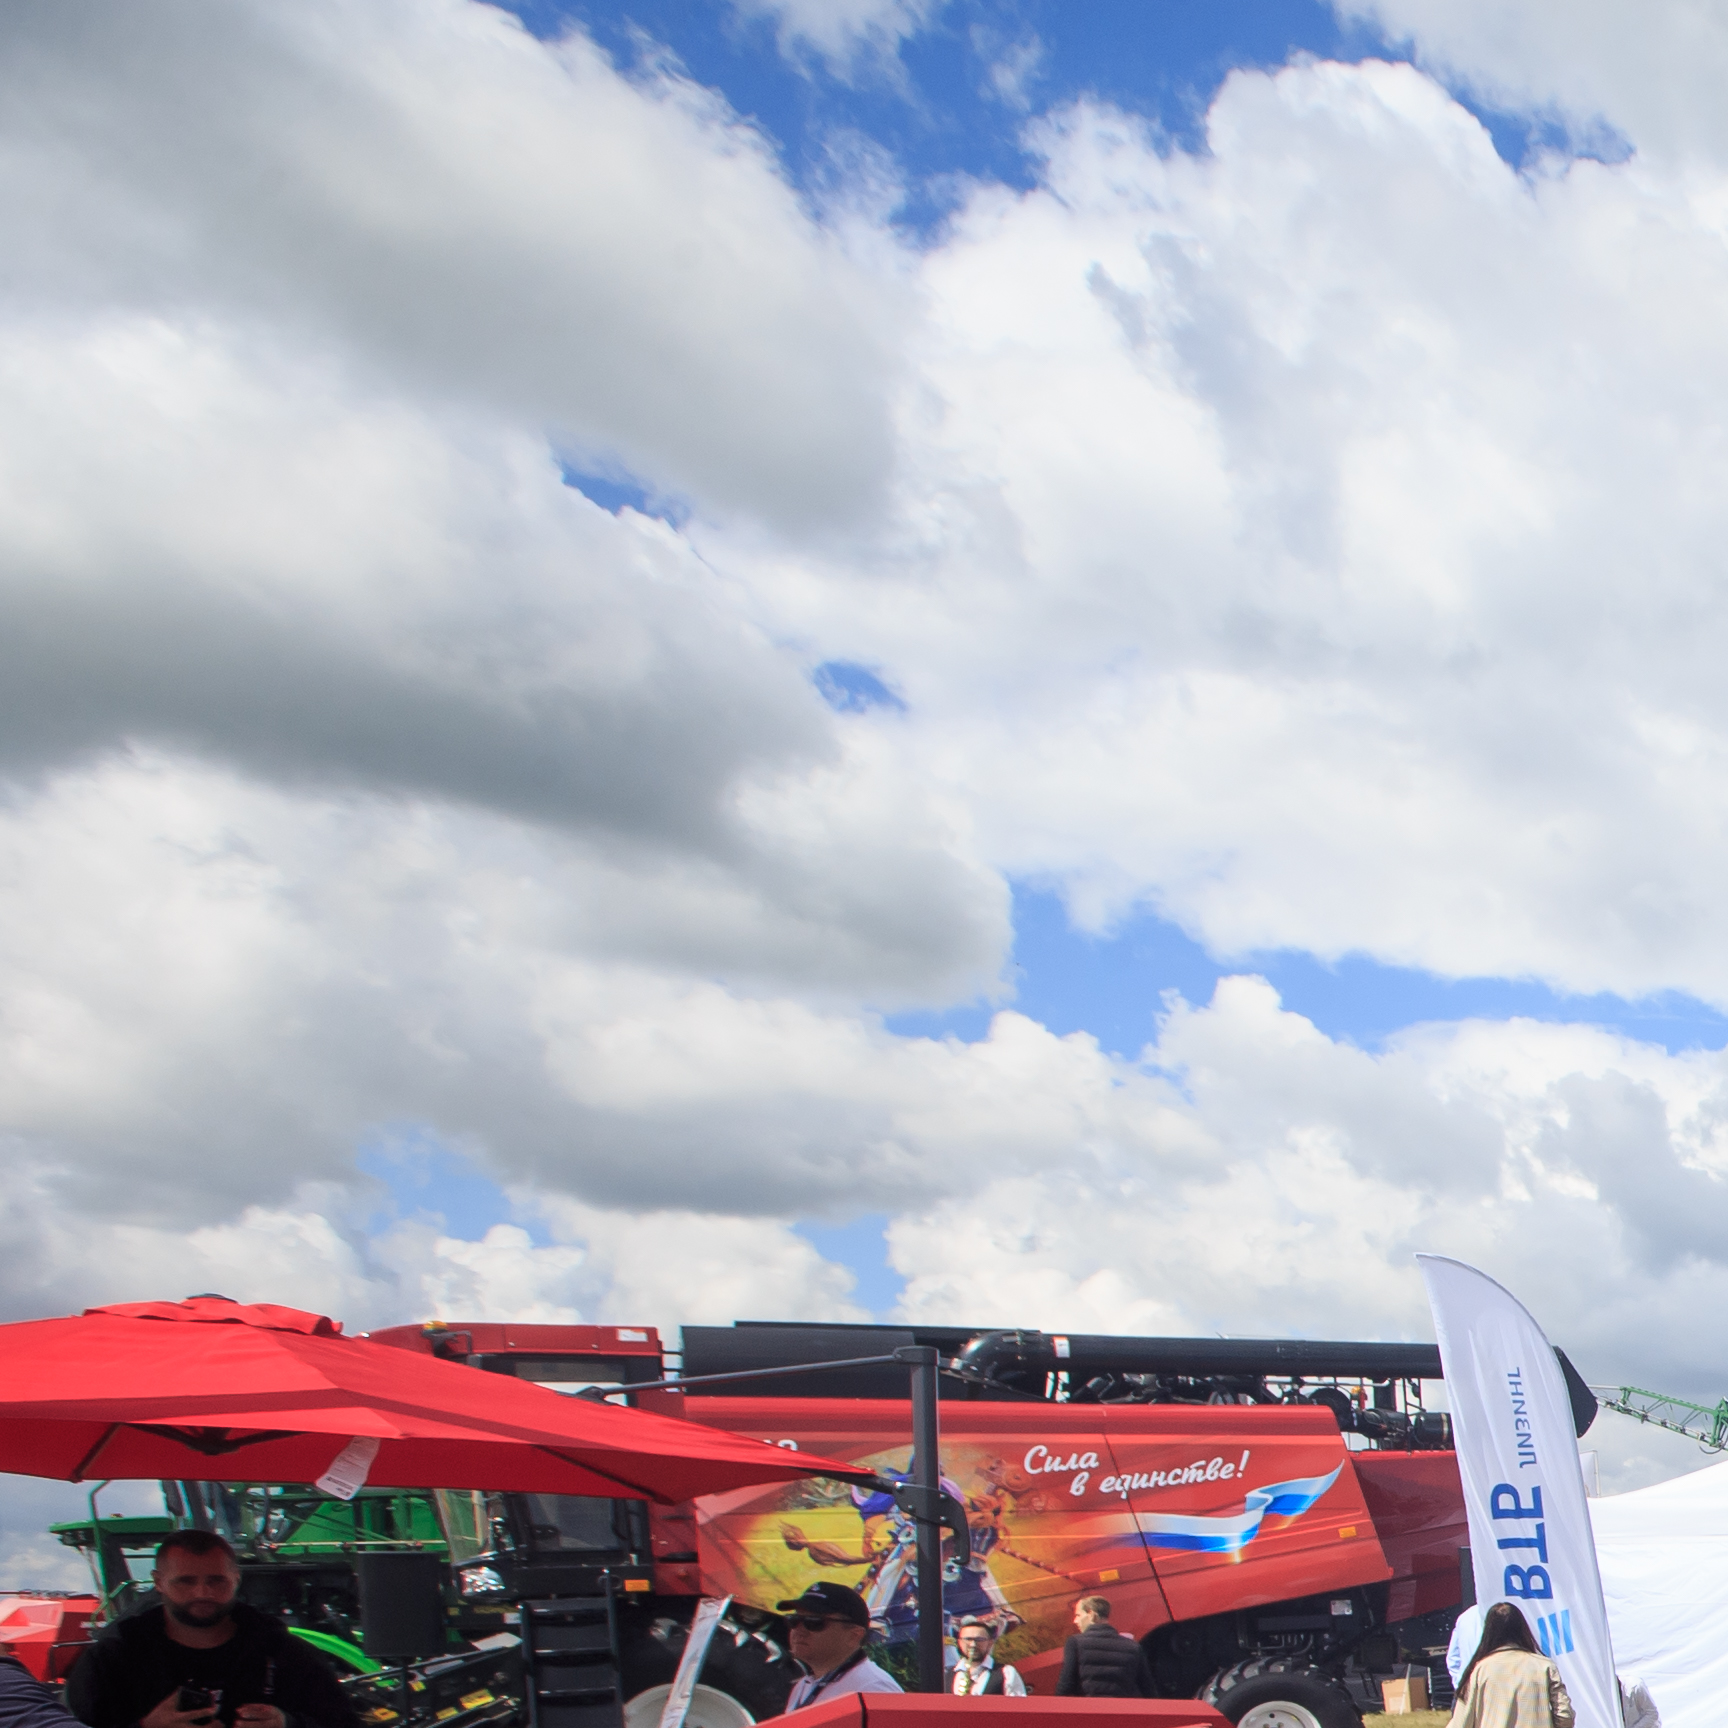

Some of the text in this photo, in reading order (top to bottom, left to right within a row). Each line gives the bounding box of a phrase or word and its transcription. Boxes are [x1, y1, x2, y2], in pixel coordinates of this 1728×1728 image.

[1024, 1444, 1099, 1474] Сила
[1069, 1450, 1250, 1499] в единстве!
